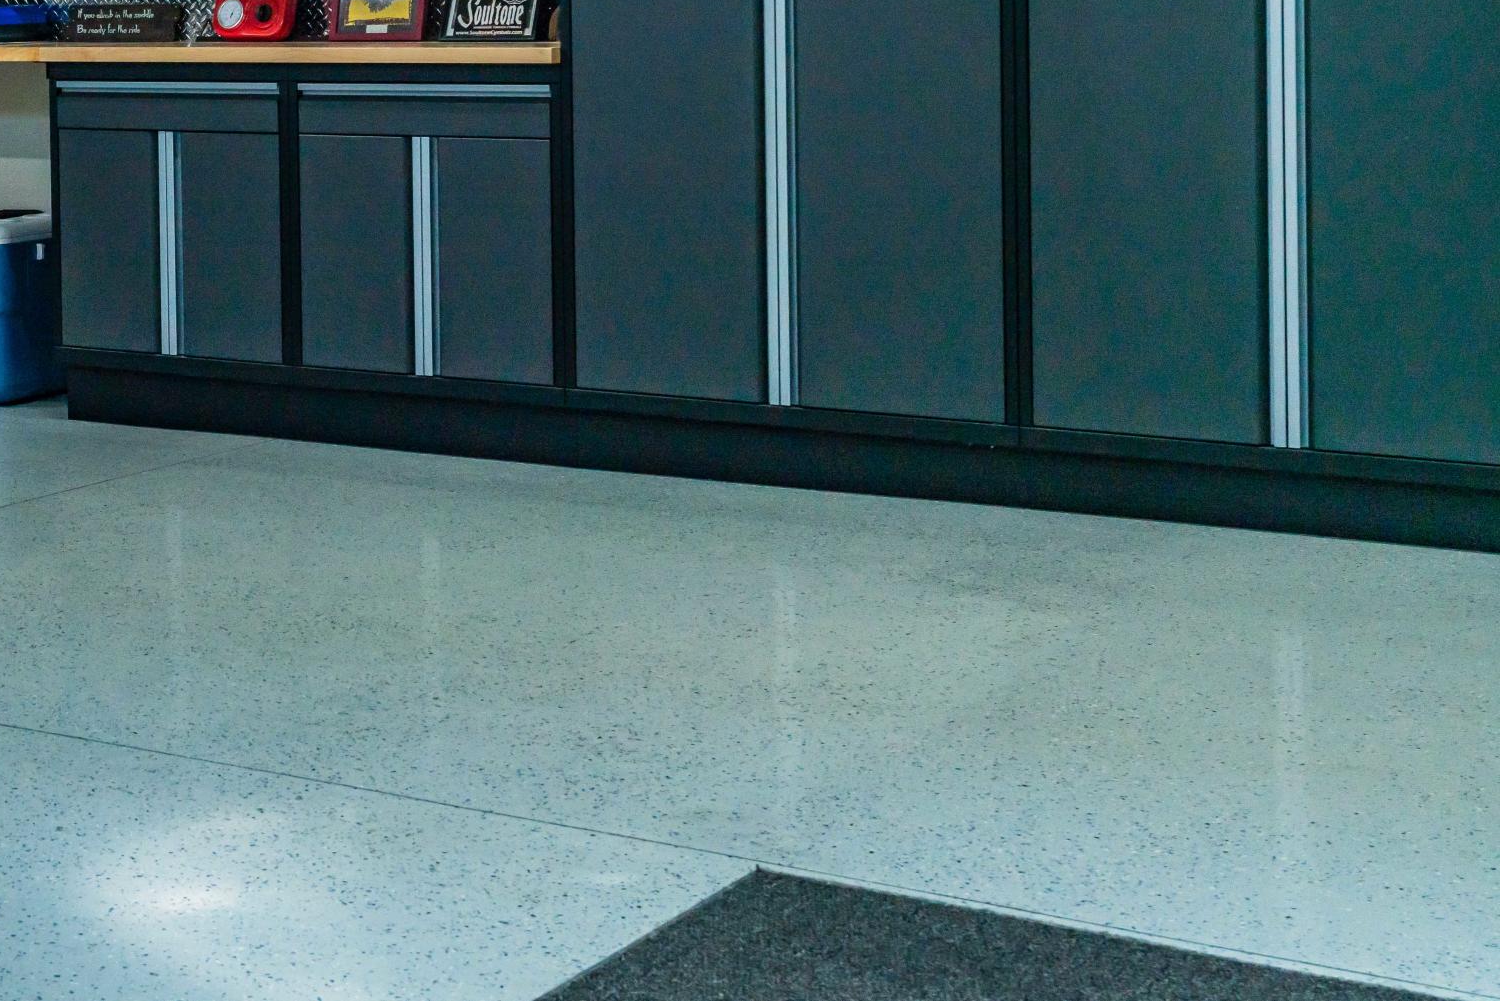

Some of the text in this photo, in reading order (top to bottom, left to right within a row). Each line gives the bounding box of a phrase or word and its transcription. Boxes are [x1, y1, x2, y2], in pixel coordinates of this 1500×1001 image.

[76, 25, 87, 34] Be
[88, 24, 106, 35] ready
[128, 24, 140, 34] ride
